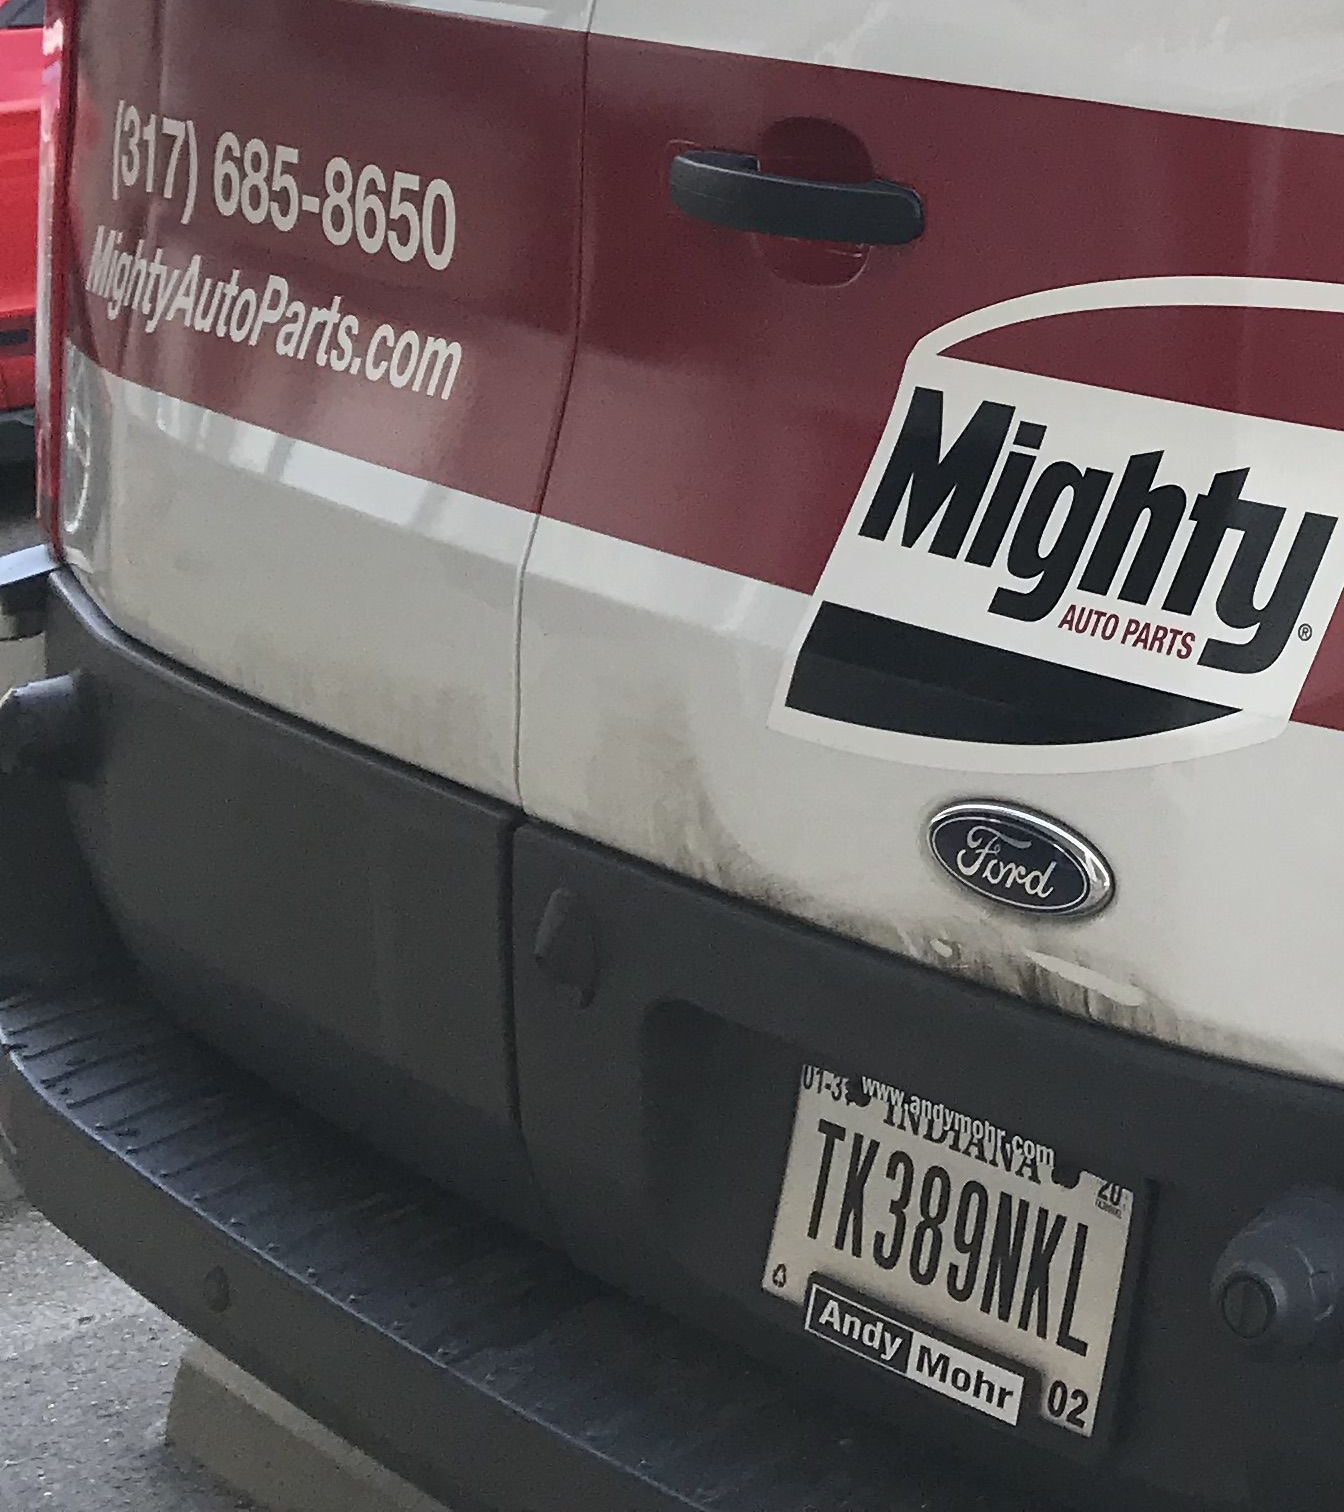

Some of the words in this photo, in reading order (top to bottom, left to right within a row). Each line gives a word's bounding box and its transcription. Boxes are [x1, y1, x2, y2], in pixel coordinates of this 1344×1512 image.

[112, 100, 198, 224] (317)
[214, 132, 456, 270] 685-8650
[87, 226, 462, 400] MightyAutoParts.com
[858, 386, 1338, 674] Mighty
[1058, 604, 1117, 640] AUTO
[1120, 619, 1196, 660] PARTS
[957, 825, 1057, 898] Ford
[862, 1076, 1055, 1168] www.andymohr.com
[883, 1103, 1041, 1185] INDIANA
[807, 1118, 1090, 1358] TK389NKL
[818, 1300, 903, 1361] Andy
[916, 1345, 1014, 1410] Mohr
[1047, 1380, 1090, 1428] 02
